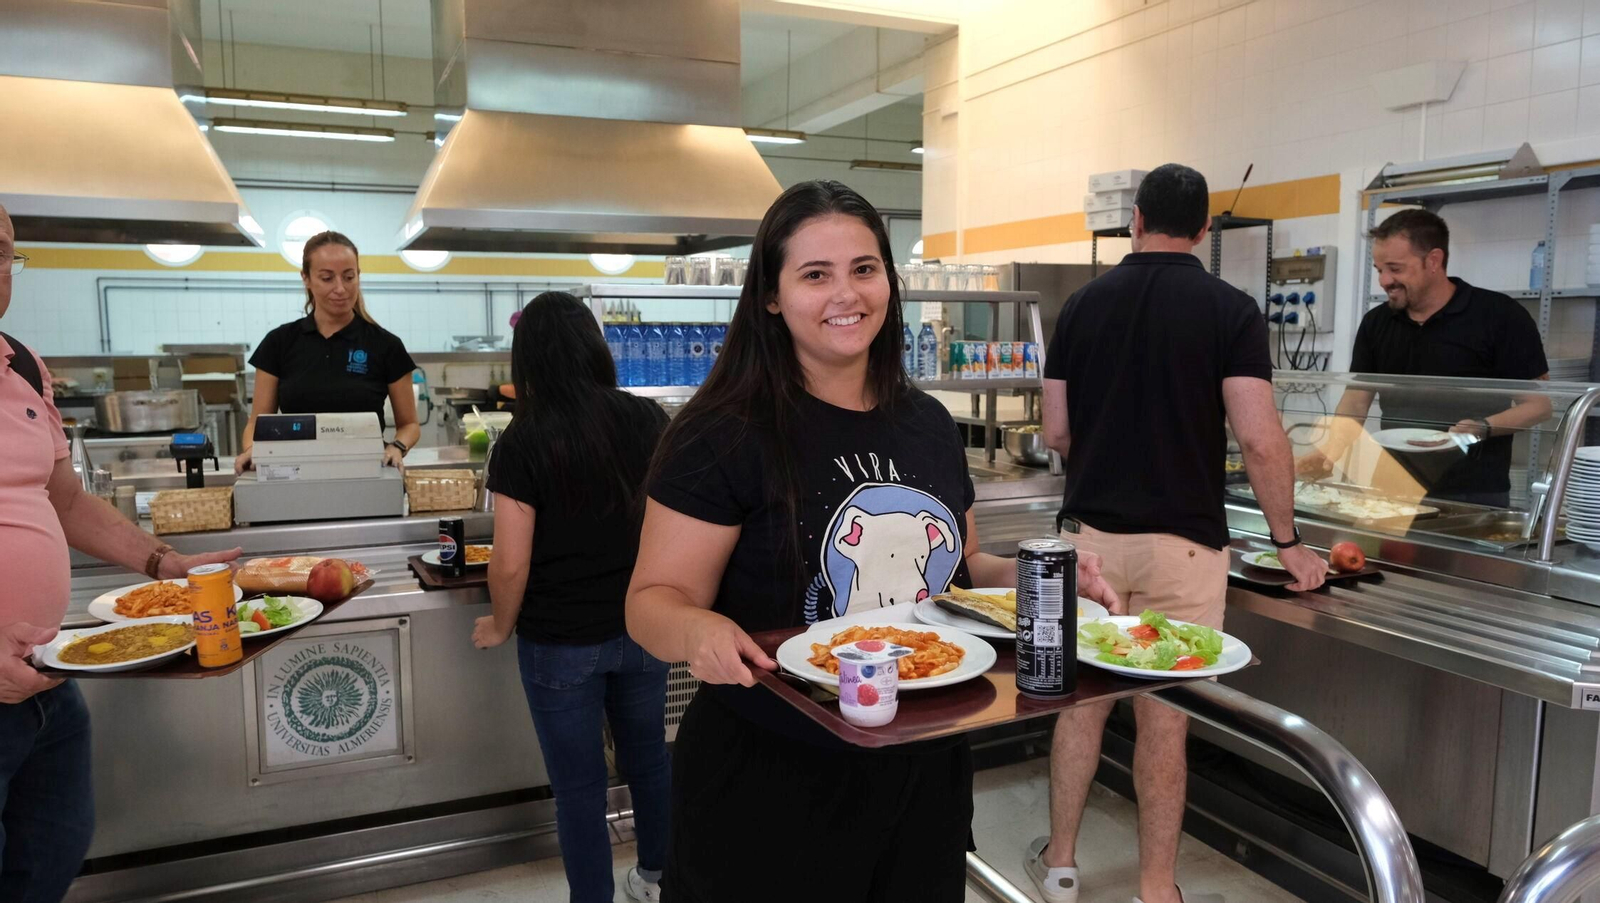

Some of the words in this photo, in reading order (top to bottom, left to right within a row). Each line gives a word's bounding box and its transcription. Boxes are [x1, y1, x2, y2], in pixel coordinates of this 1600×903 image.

[833, 452, 901, 482] VIRA
[193, 611, 213, 623] AS
[226, 604, 237, 618] K
[267, 683, 281, 699] IN
[274, 643, 327, 681] LUMINE
[333, 642, 390, 687] SAPIENTIA
[1586, 693, 1600, 702] FA
[267, 711, 330, 757] UNIVERSITAS
[338, 698, 394, 755] ALMERIENSIS
